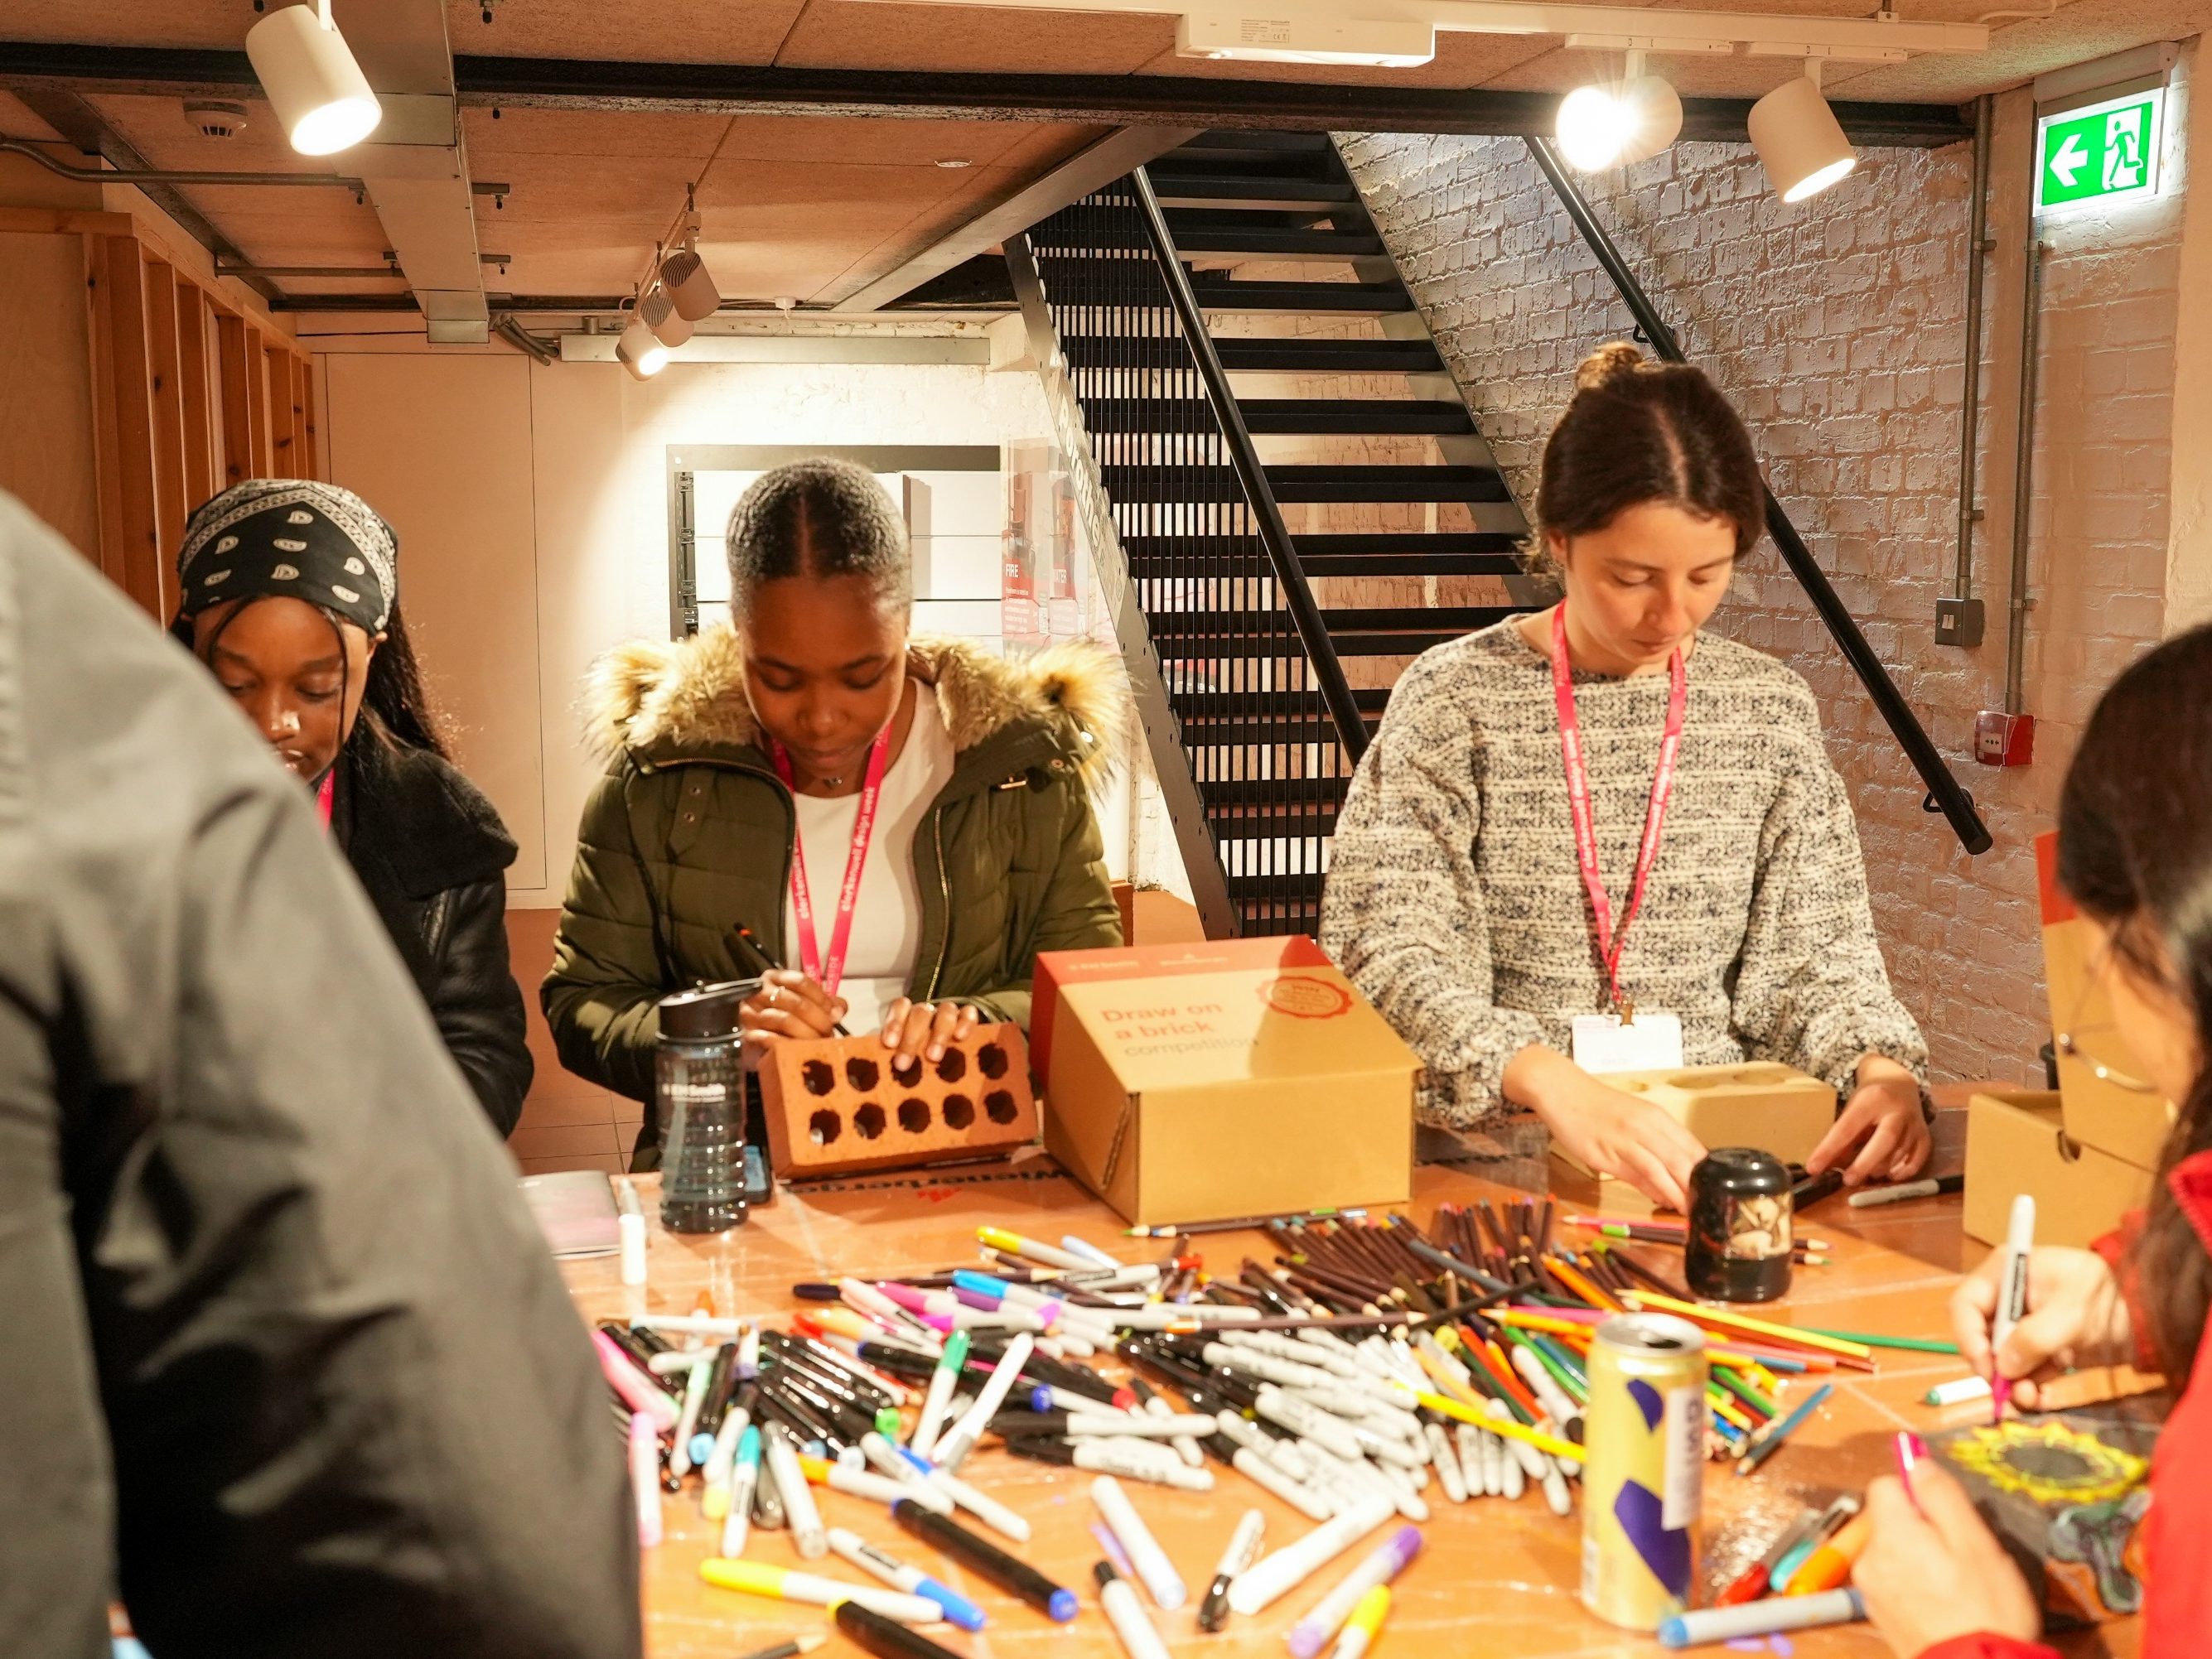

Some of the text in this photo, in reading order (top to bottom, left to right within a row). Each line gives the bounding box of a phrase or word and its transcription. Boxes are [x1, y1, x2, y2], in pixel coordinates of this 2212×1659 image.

[1005, 563, 1019, 578] FIRE
[1564, 728, 1577, 760] week
[1570, 760, 1584, 798] design
[1655, 765, 1671, 803] design
[854, 814, 871, 847] design
[863, 787, 875, 814] week
[1101, 1004, 1222, 1022] Draw on
[1115, 1020, 1214, 1039] a brick
[1125, 1036, 1259, 1057] competition
